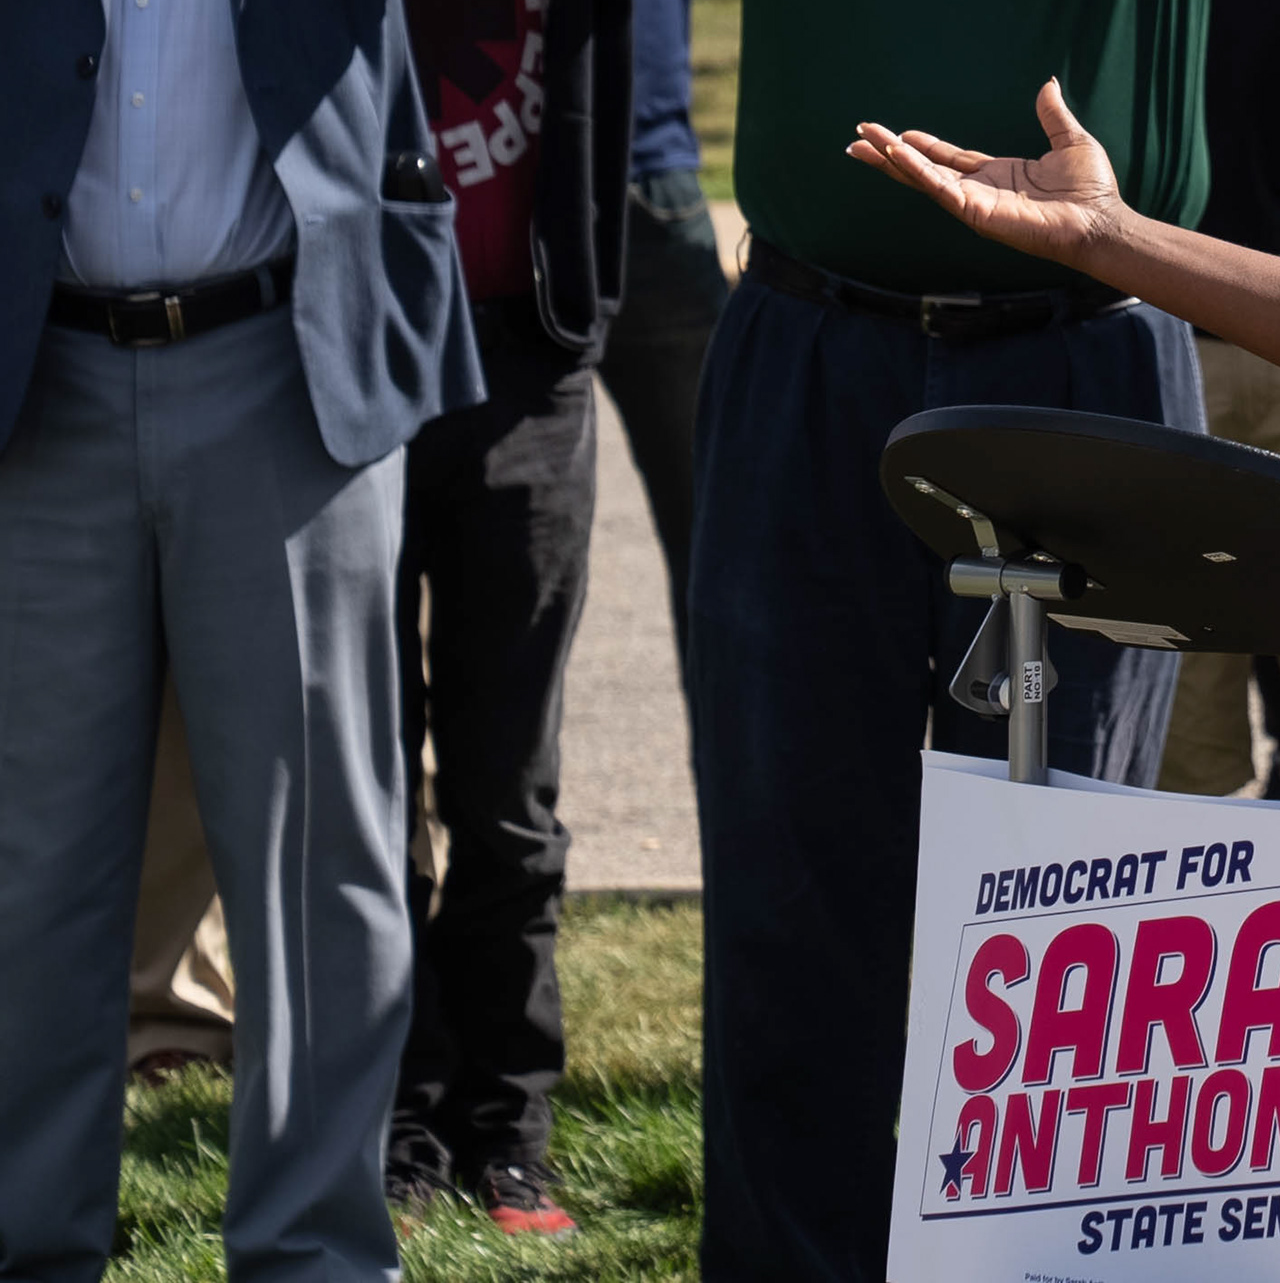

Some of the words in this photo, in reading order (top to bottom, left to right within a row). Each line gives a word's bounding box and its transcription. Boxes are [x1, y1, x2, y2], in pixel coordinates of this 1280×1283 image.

[975, 850, 1168, 915] DEMOCRAT
[1176, 840, 1254, 891] FOR
[1077, 1201, 1208, 1254] STATE
